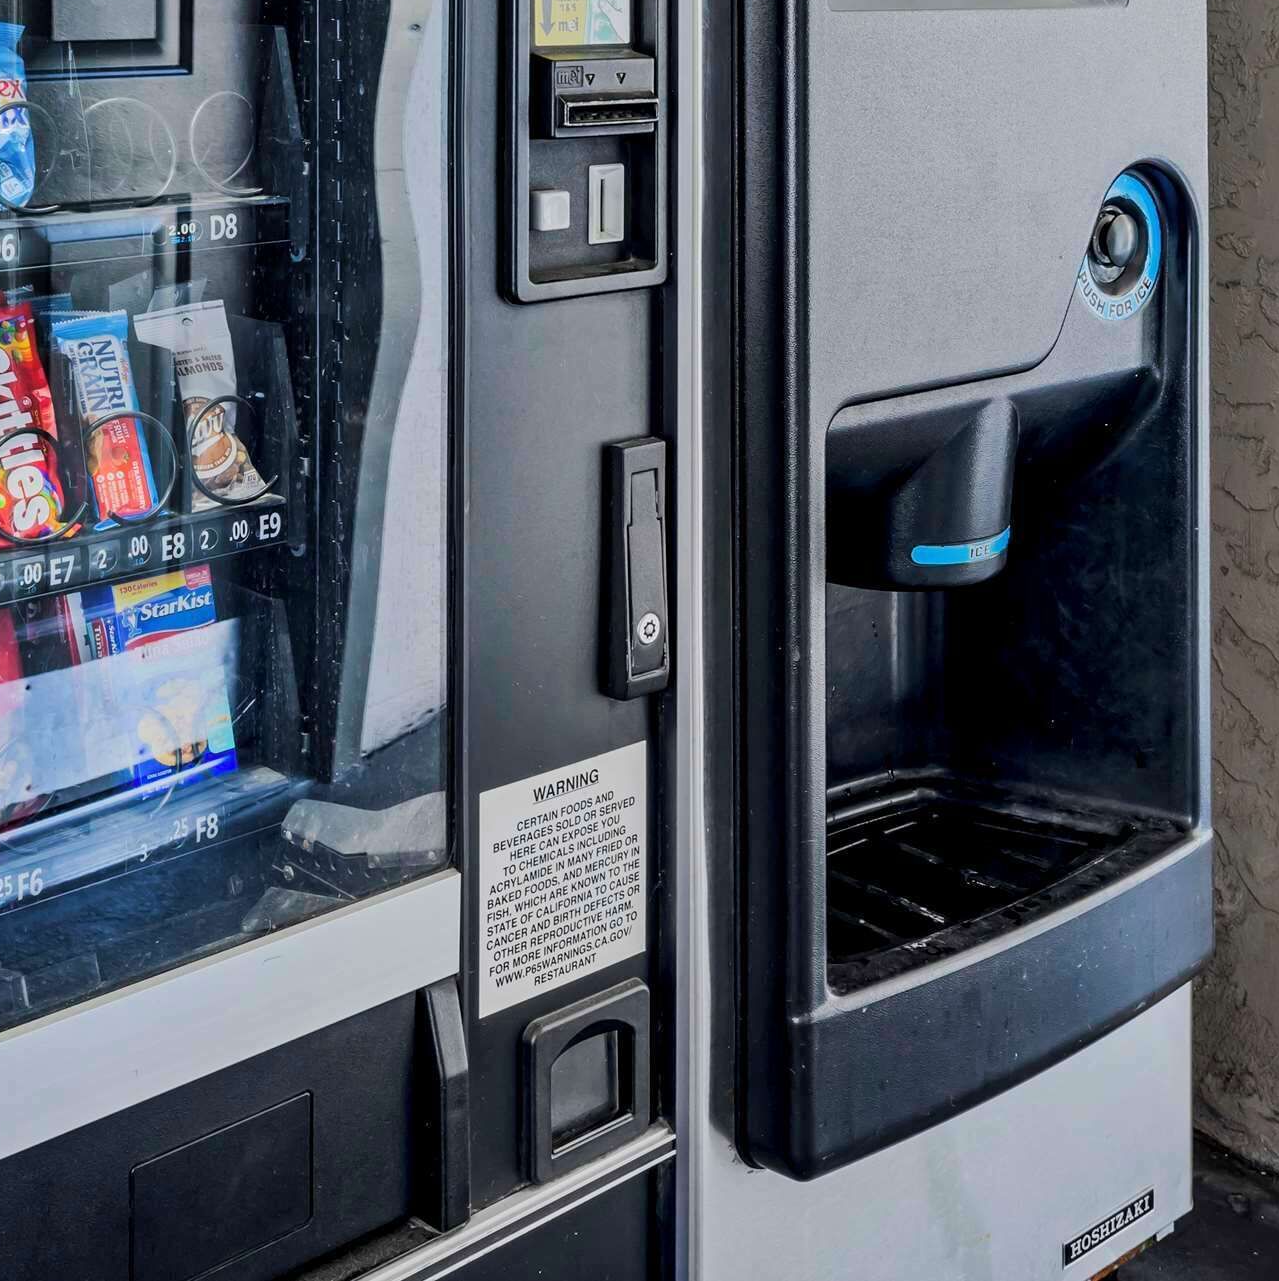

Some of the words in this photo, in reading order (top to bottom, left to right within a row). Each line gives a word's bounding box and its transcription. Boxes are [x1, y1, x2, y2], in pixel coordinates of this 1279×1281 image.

[558, 17, 578, 32] mei
[210, 215, 237, 240] D8
[1078, 272, 1106, 314] PUSH
[1109, 300, 1132, 317] FOR
[1134, 277, 1152, 304] ICE
[77, 342, 110, 415] GRAIN
[92, 340, 127, 410] NUTRI
[112, 420, 126, 444] FRUIT
[162, 532, 185, 561] E8
[259, 512, 281, 541] E9
[50, 556, 74, 586] E7
[970, 545, 990, 558] ICE
[132, 580, 158, 593] Calories
[141, 590, 212, 621] StarKist
[533, 769, 598, 802] WARNING
[196, 812, 219, 843] F8
[493, 825, 553, 853] BEVERAGES
[556, 816, 580, 831] SOLD
[584, 809, 596, 821] OR
[600, 796, 635, 816] SERVED
[517, 810, 557, 831] CERTAIN
[561, 798, 593, 817] FOODS
[595, 791, 613, 804] AND
[504, 865, 516, 876] TO
[520, 844, 574, 871] CHEMICALS
[577, 826, 626, 850] INCLUDING
[510, 844, 536, 861] HERE
[539, 835, 558, 851] CAN
[562, 822, 598, 843] EXPOSE
[602, 814, 620, 828] YOU
[17, 869, 43, 901] F6
[487, 890, 521, 910] BAKED
[563, 868, 582, 882] AND
[585, 851, 628, 873] MERCURY
[631, 846, 639, 858] IN
[490, 865, 552, 895] ACRYLAMIDE
[556, 861, 564, 872] IN
[568, 850, 593, 866] MANY
[597, 840, 622, 857] FRIED
[625, 834, 638, 846] OR
[487, 908, 511, 924] FISH,
[515, 893, 546, 913] WHICH
[549, 886, 568, 901] ARE
[571, 872, 605, 892] KNOWN
[609, 867, 620, 877] TO
[623, 859, 639, 871] THE
[487, 918, 517, 937] STATE
[521, 912, 533, 924] OF
[536, 890, 592, 918] CALIFORNIA
[595, 884, 606, 896] TO
[609, 872, 639, 890] CAUSE
[486, 927, 527, 951] CANCER
[530, 920, 550, 934] AND
[553, 907, 580, 926] BIRTH
[584, 891, 624, 914] DEFECTS
[627, 884, 640, 896] OR
[493, 941, 527, 962] OTHER
[531, 912, 602, 948] REPRODUCTIVE
[606, 900, 633, 919] HARM.
[489, 961, 509, 977] FOR
[513, 949, 540, 968] MORE
[544, 924, 607, 956] INFORMATION
[609, 917, 623, 929] GO
[626, 911, 637, 921] TO
[534, 953, 597, 986] RESTAURANT
[1069, 1195, 1150, 1259] HOSHIZAKI
